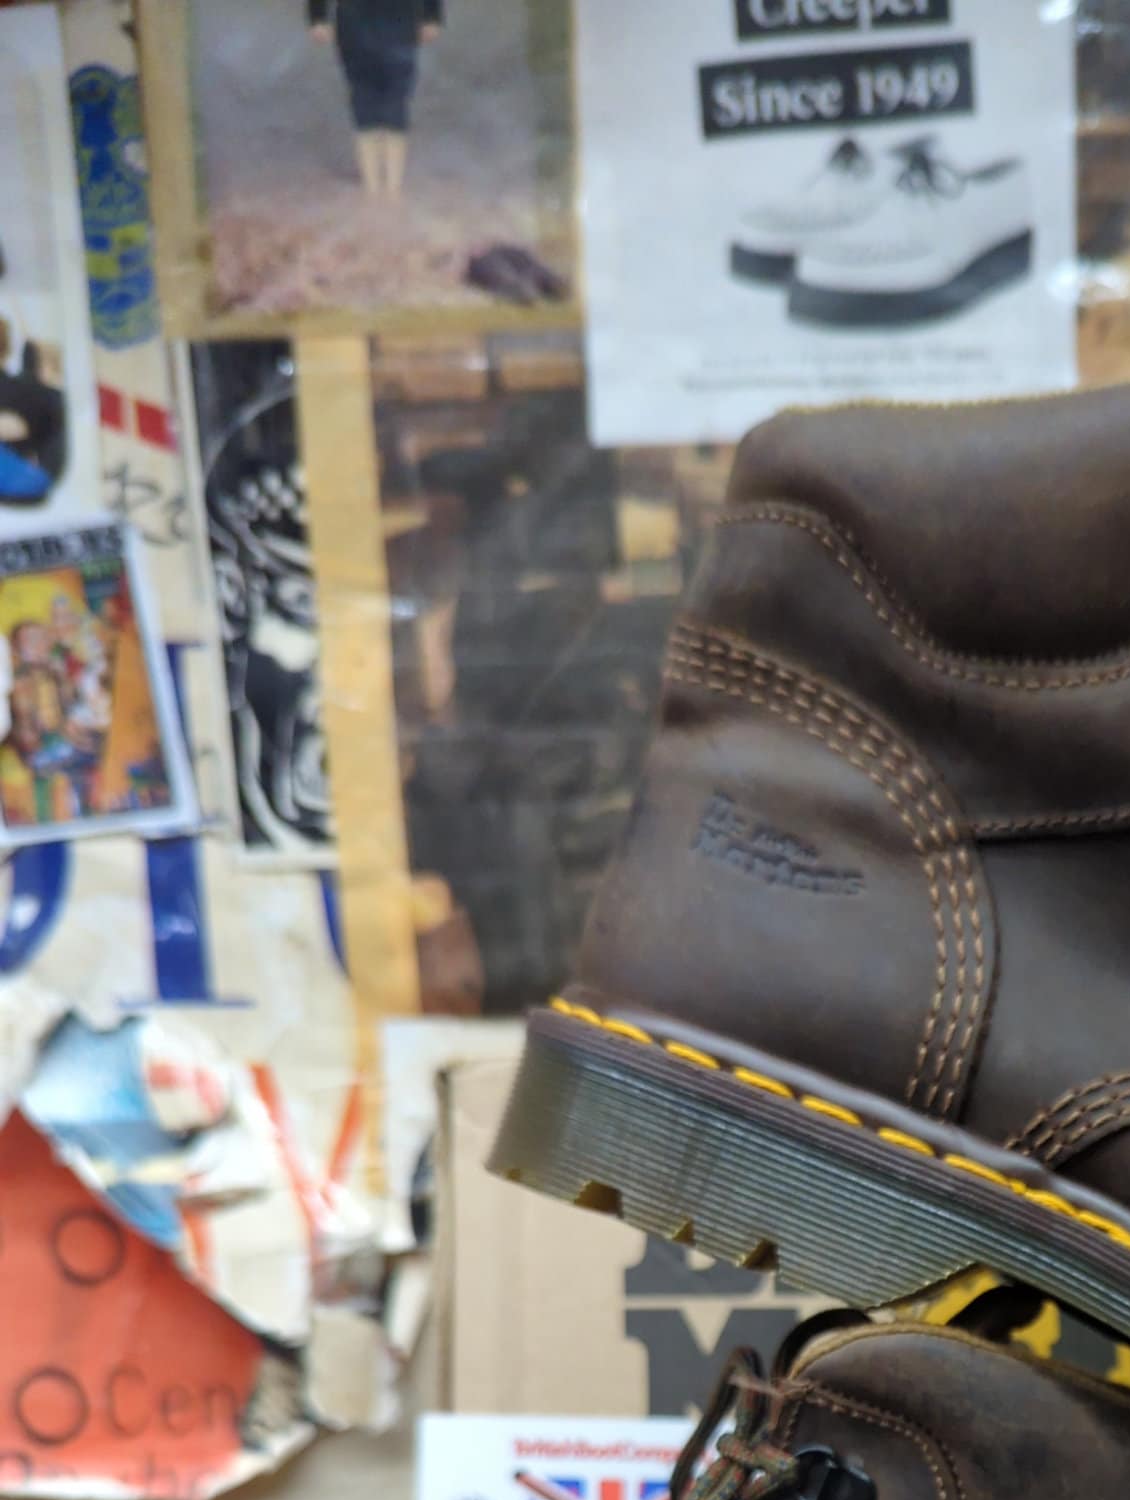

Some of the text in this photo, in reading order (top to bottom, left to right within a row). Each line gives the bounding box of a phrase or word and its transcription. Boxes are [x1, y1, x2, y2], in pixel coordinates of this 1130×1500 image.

[748, 0, 932, 31] Creeper
[711, 62, 961, 127] Since 1949
